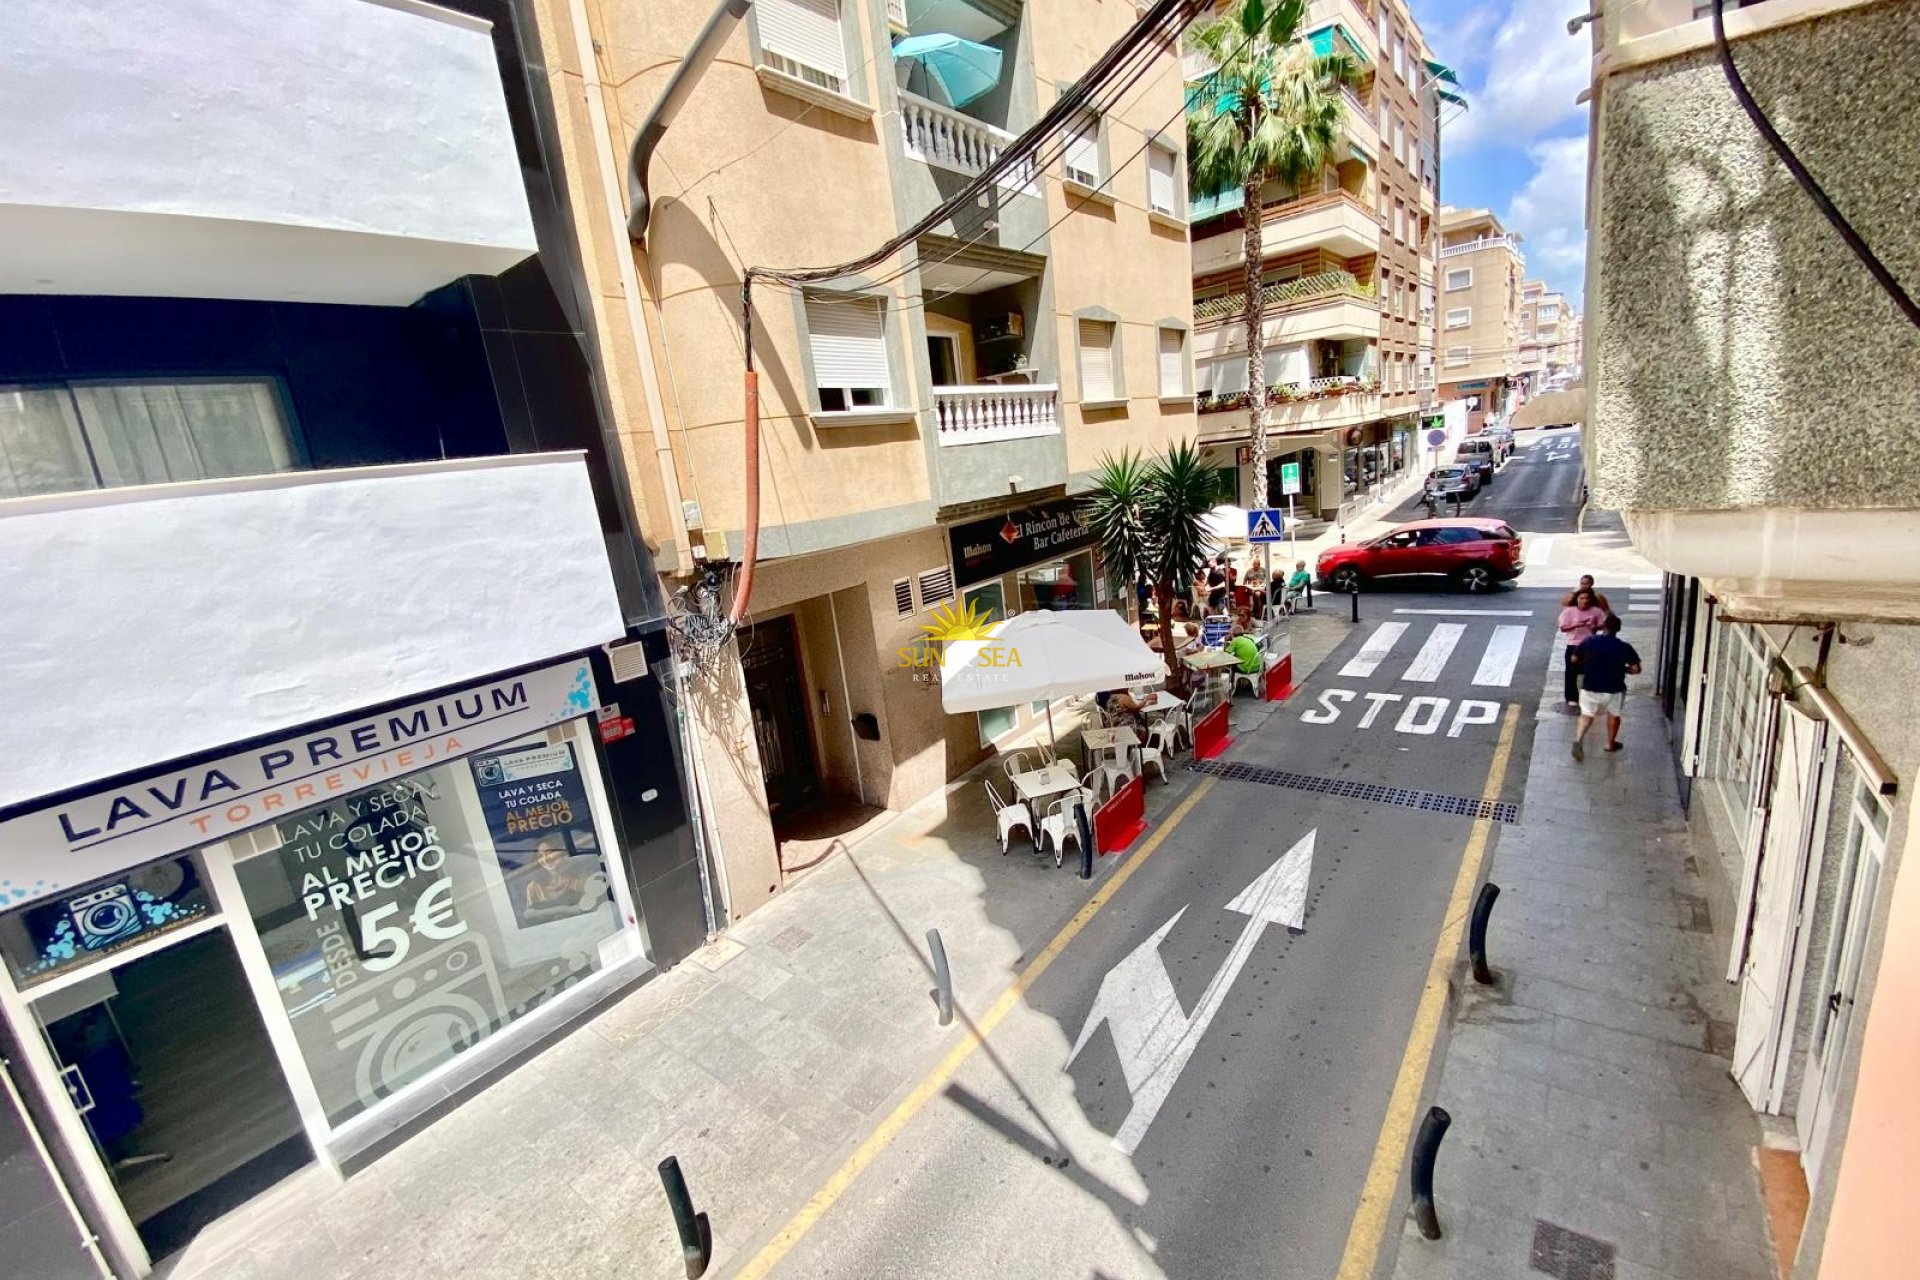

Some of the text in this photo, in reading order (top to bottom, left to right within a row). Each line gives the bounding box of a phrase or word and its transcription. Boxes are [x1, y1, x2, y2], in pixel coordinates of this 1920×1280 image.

[1033, 536, 1049, 551] Bar
[1059, 511, 1070, 526] de
[963, 543, 992, 559] Mahou
[1125, 672, 1156, 681] Mahou
[1299, 688, 1501, 738] STOP
[58, 682, 528, 843] LAVA PREMIUM
[190, 736, 464, 834] TORREVIEJA
[280, 783, 431, 845] LAVA Y SECA
[499, 780, 563, 799] LAVA Y SECA
[505, 791, 562, 808] TU COLADA
[507, 800, 570, 820] AL MEJOR
[294, 806, 426, 863] TU COLADA
[508, 809, 573, 835] PRECIO
[302, 825, 440, 894] AL MEJOR
[303, 845, 446, 921] PRECIO
[360, 876, 469, 972] 5€
[316, 920, 358, 989] DESDE
